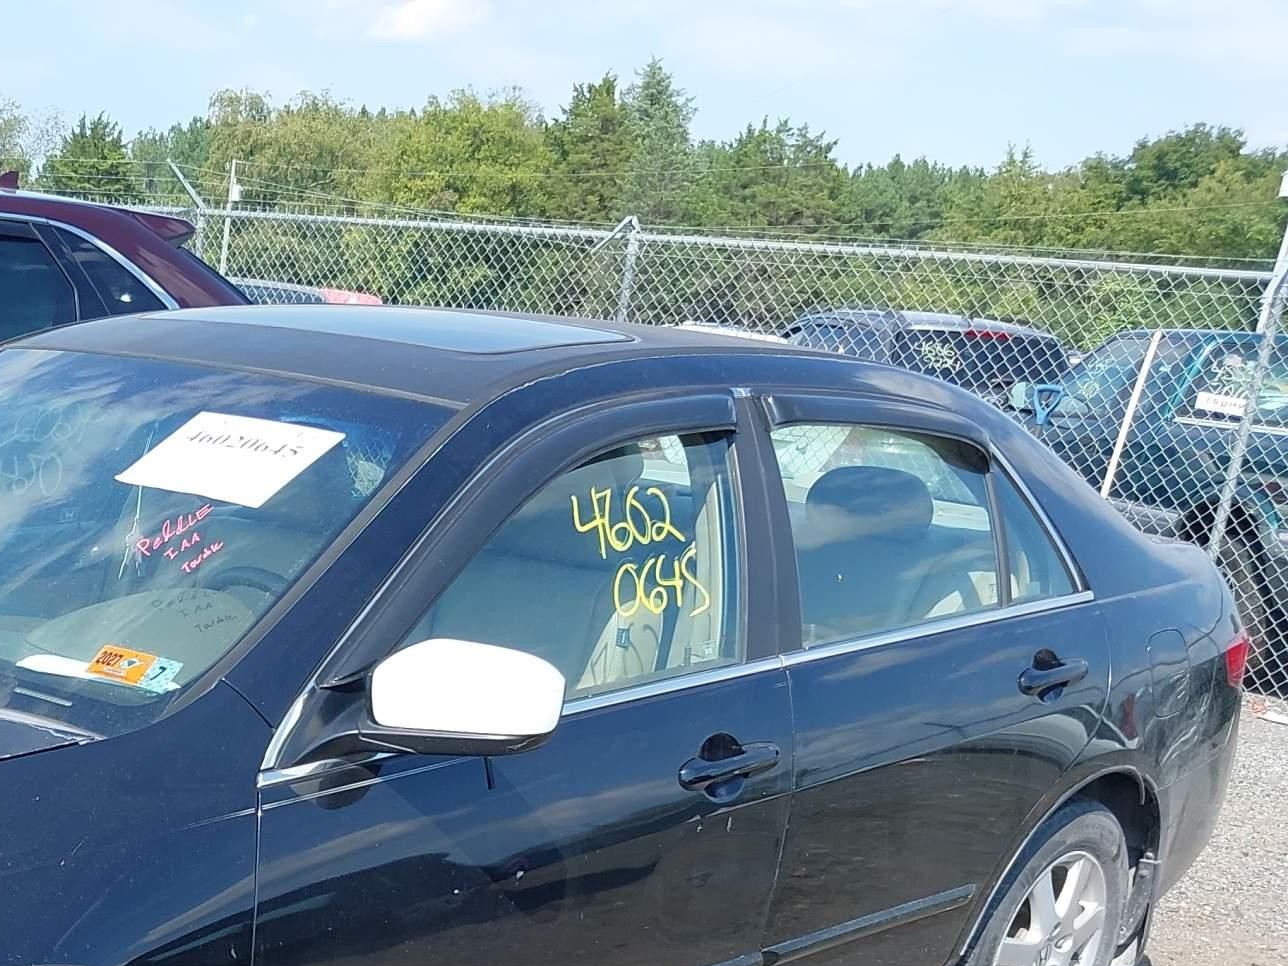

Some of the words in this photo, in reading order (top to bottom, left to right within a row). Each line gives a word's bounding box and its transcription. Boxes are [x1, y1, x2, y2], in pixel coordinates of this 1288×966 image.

[571, 486, 686, 560] 4602
[614, 541, 710, 617] 0645
[94, 650, 124, 667] 2027
[149, 665, 167, 682] 7
